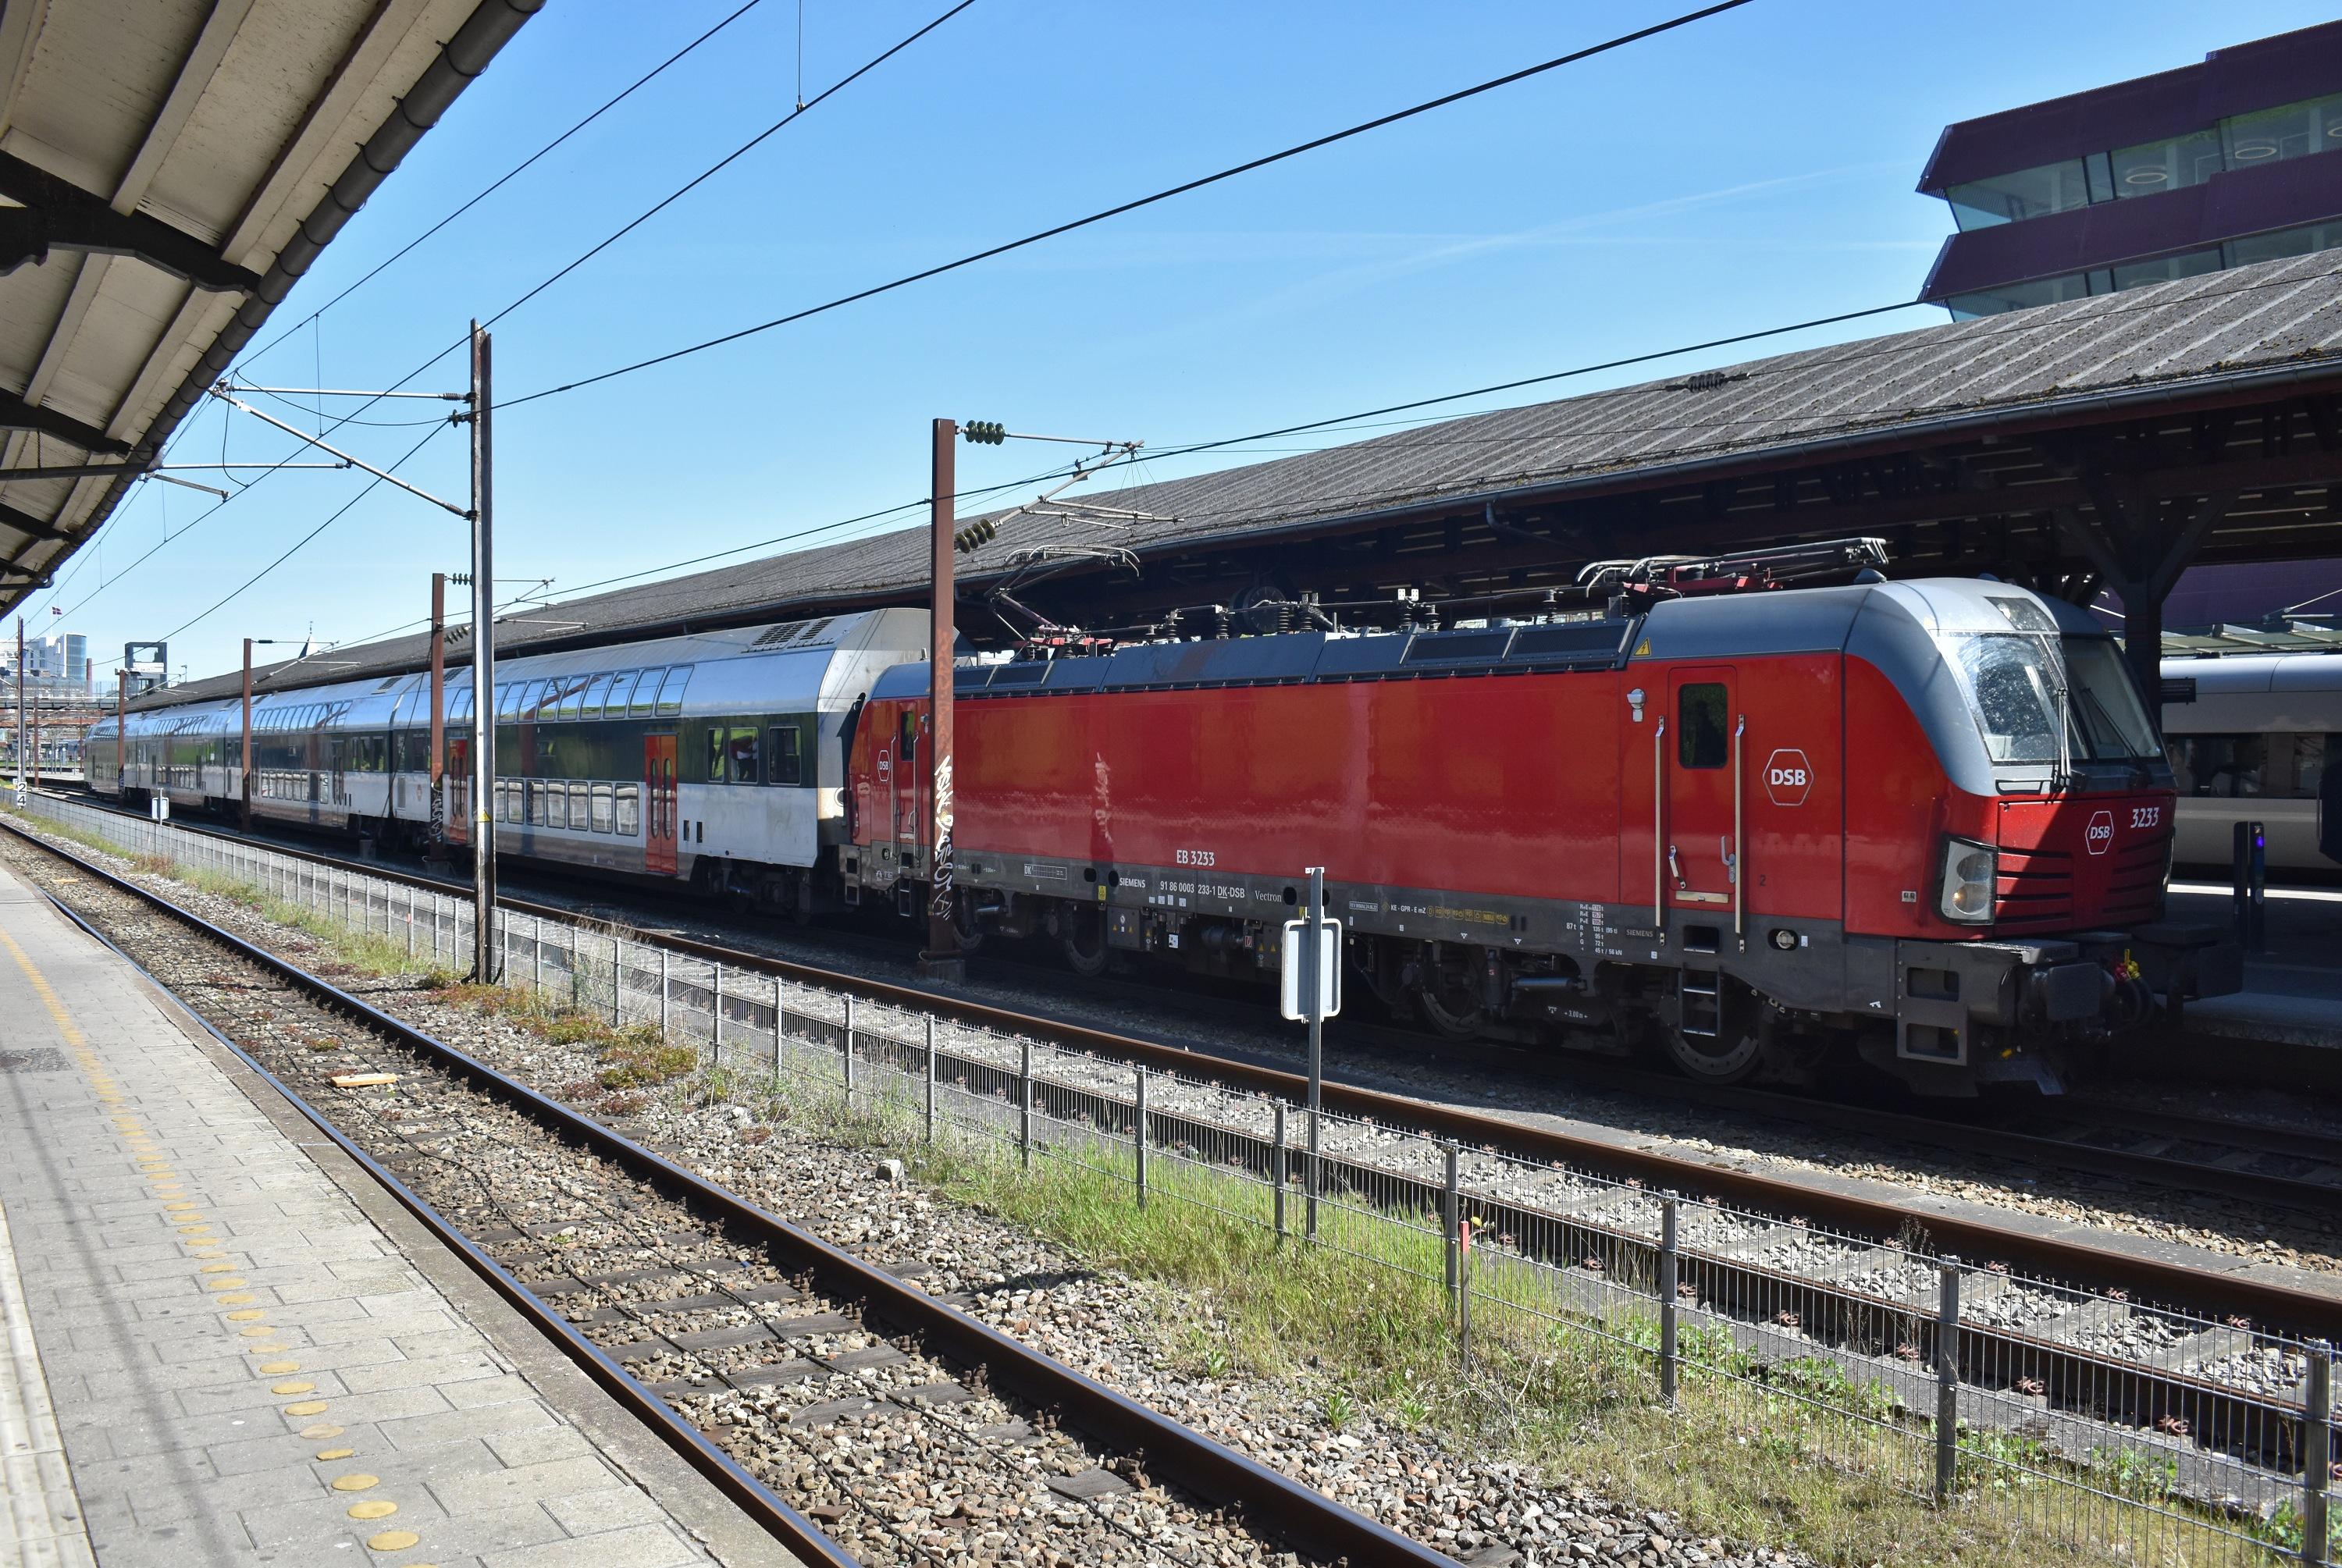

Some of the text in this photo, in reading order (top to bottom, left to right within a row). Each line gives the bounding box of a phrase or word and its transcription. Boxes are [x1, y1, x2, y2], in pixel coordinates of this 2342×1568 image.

[879, 761, 889, 770] DSB
[1771, 769, 1806, 786] DSB
[19, 783, 26, 792] 2
[17, 795, 26, 805] 4
[2130, 807, 2159, 828] 3233
[2090, 826, 2110, 839] DSB
[1176, 849, 1215, 866] EB 3233
[1119, 877, 1145, 888] SIEMENS
[1760, 874, 1766, 887] 2
[1160, 881, 1245, 898] 91 86 0003 233-1 DK-DSB
[1255, 891, 1282, 902] Vectron
[1626, 929, 1653, 937] SIEMENS
